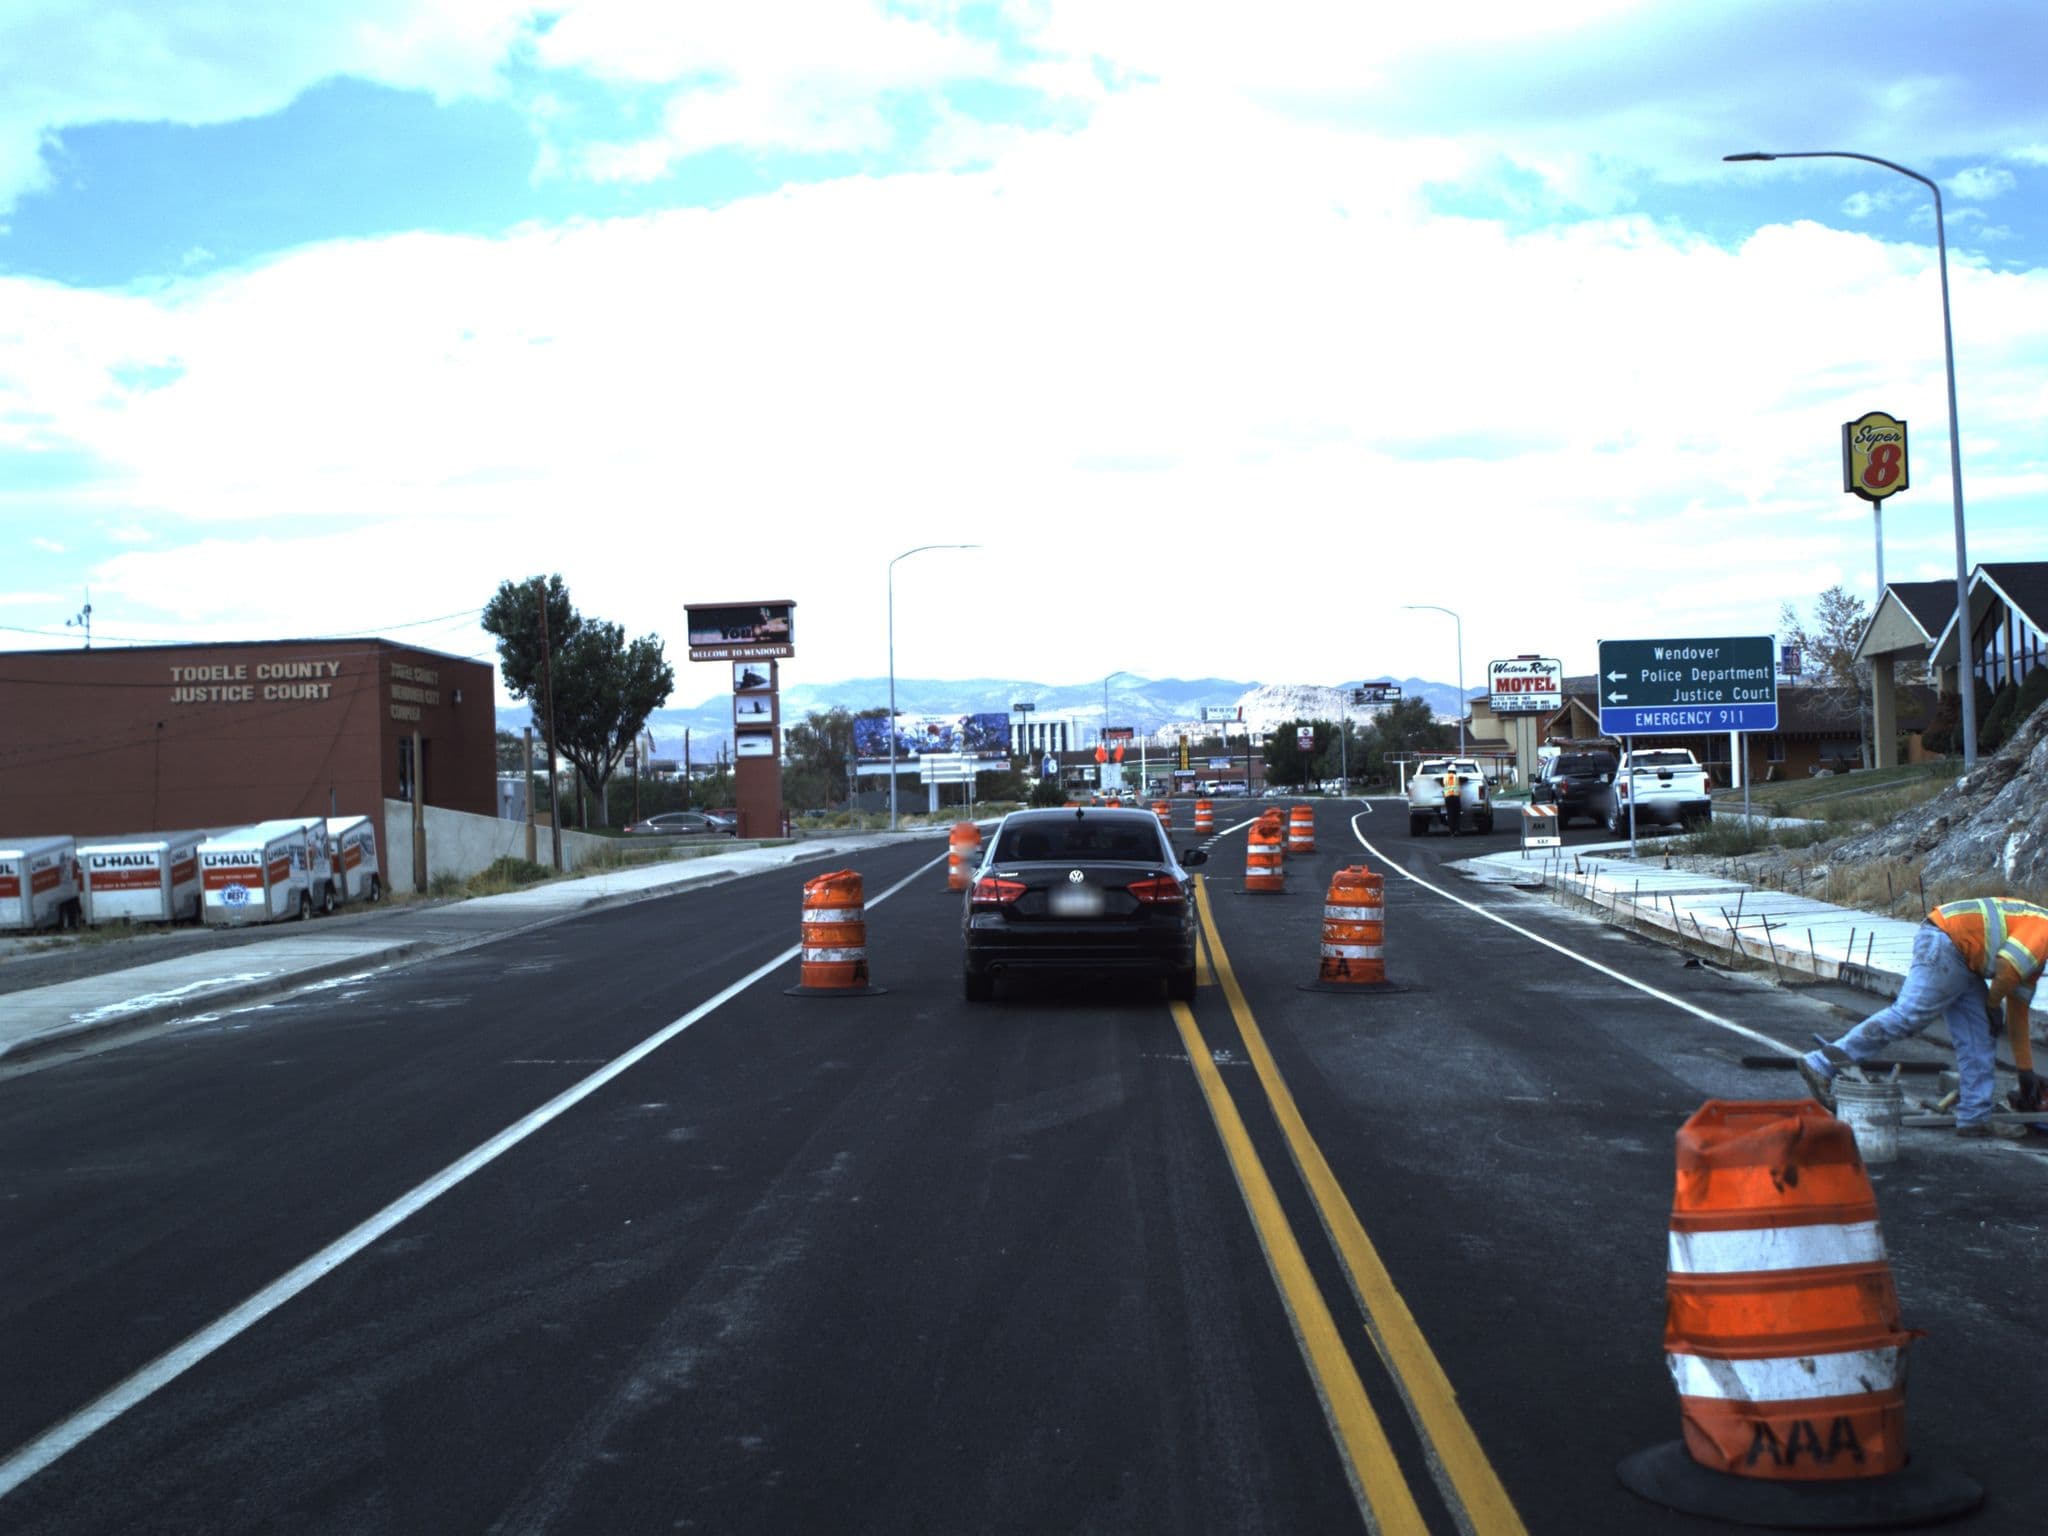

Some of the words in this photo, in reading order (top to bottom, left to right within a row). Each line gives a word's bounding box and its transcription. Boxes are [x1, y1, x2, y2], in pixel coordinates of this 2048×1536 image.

[1856, 425, 1901, 451] Super
[1863, 444, 1901, 488] 8
[691, 650, 728, 658] WELCOME
[732, 649, 743, 657] TO
[744, 647, 787, 656] WENDOVER
[1654, 647, 1720, 661] Wendover
[170, 665, 247, 682] TOOELE
[256, 661, 341, 680] COUNTY
[1494, 662, 1528, 674] Western
[1530, 662, 1557, 675] Ridge
[1641, 669, 1682, 682] Police
[1691, 667, 1769, 683] Department
[171, 686, 254, 702] JUSTICE
[263, 683, 333, 700] COURT
[1496, 676, 1556, 693] MOTEL
[1673, 688, 1723, 702] Justice
[1733, 687, 1770, 700] Court
[1636, 711, 1712, 727] EMERGENCY
[1720, 710, 1744, 724] 911
[227, 891, 244, 900] BEST
[1746, 1417, 1866, 1467] AAA
